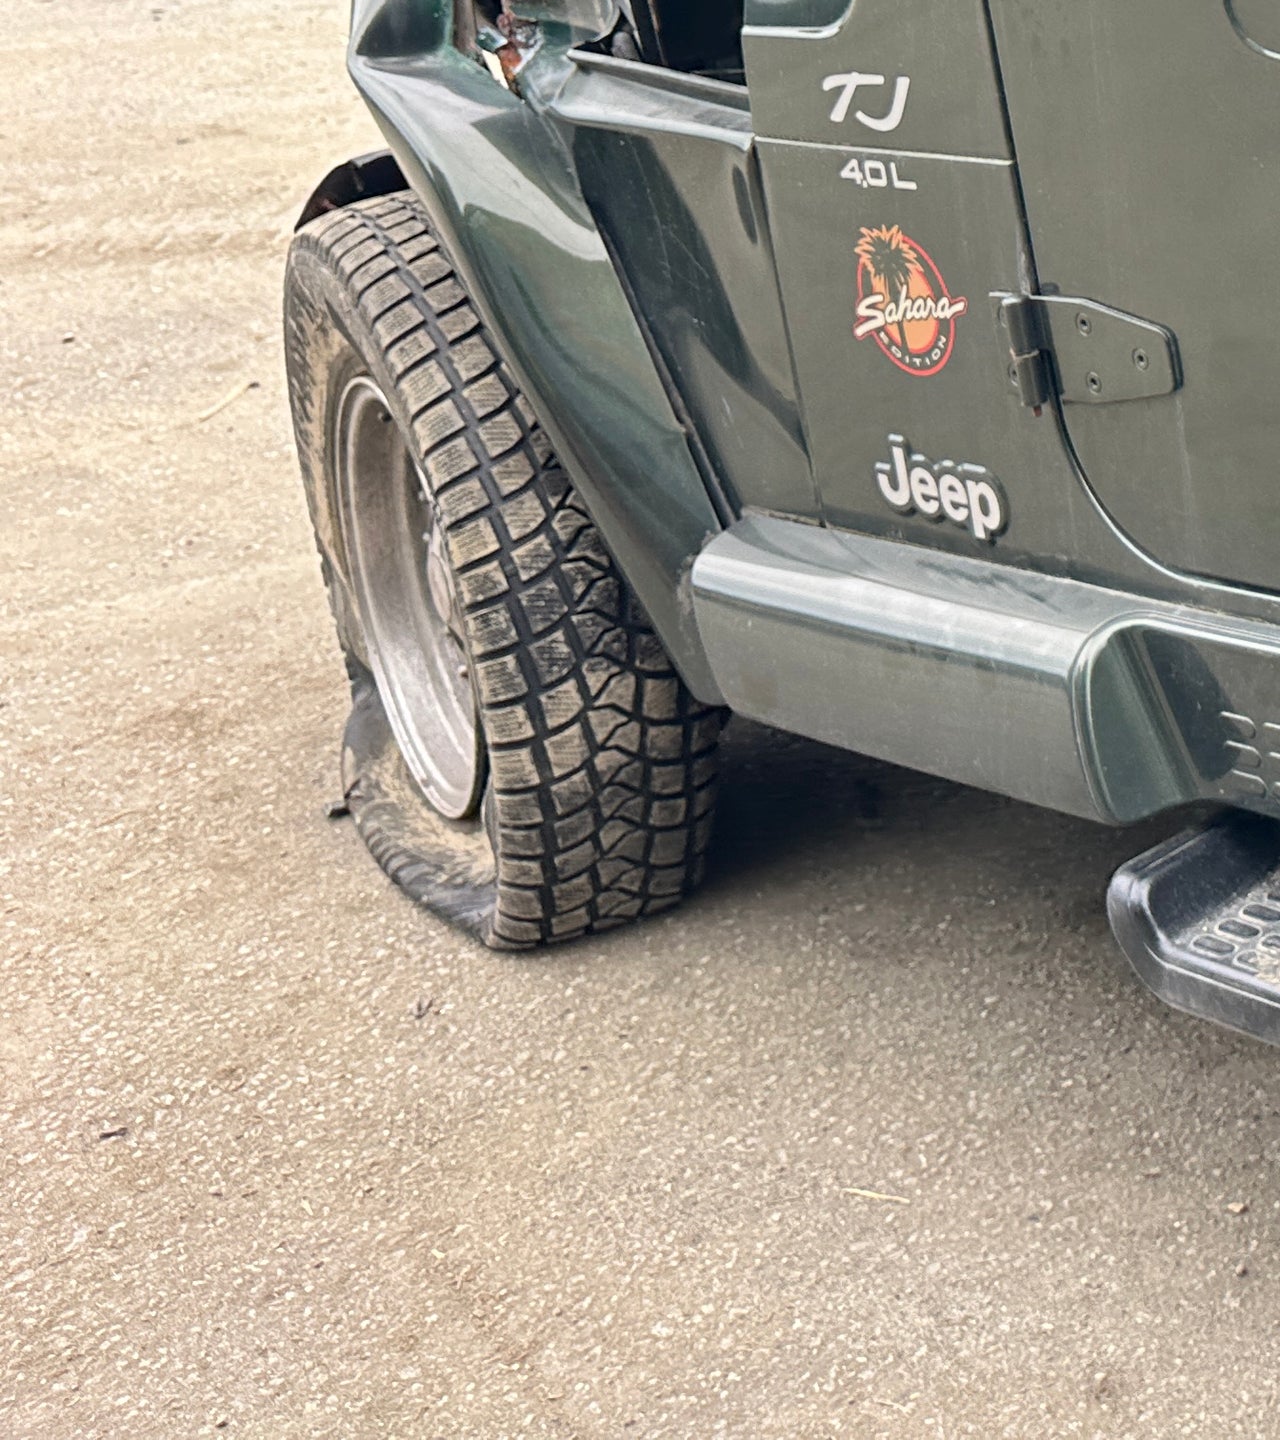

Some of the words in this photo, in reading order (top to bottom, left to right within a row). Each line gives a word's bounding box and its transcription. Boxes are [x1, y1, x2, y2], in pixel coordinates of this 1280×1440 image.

[823, 72, 911, 132] TJ
[855, 284, 965, 337] Sahara
[874, 433, 1003, 540] Jeep
